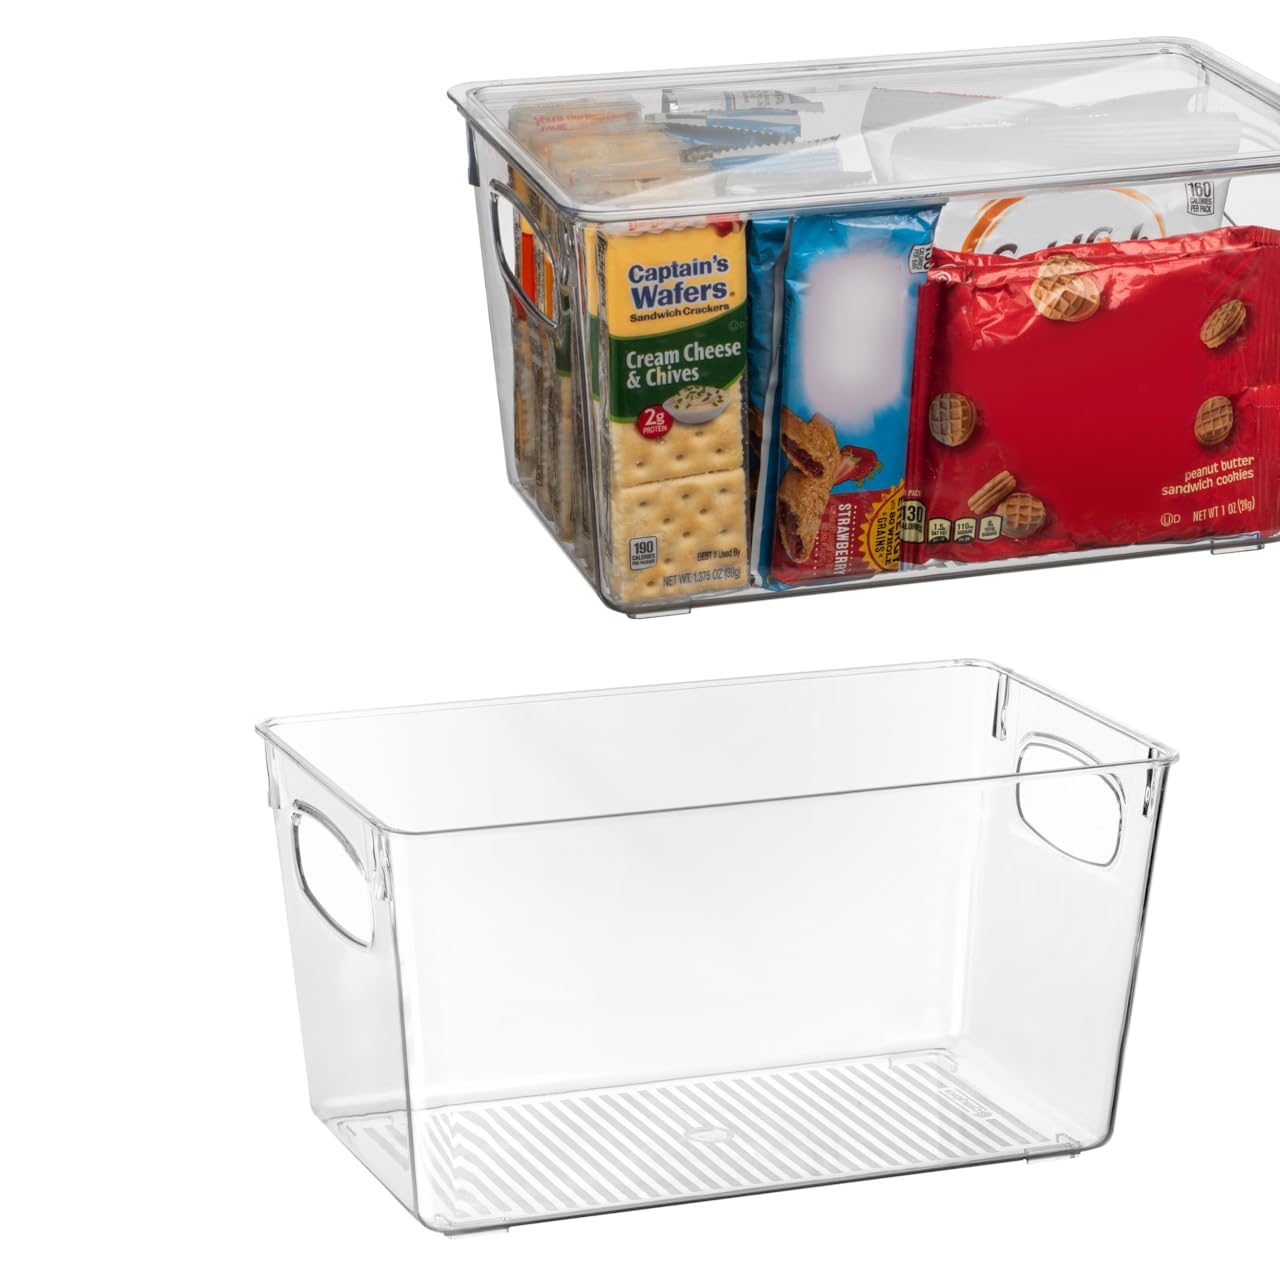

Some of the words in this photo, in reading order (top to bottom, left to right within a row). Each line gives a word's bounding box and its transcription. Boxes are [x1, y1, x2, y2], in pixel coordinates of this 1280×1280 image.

[1187, 196, 1213, 207] CALORIES
[1190, 205, 1200, 213] PER
[627, 254, 729, 285] Captain's
[630, 281, 728, 311] Wafers
[629, 308, 682, 323] Sandwich
[683, 302, 730, 316] Crackers
[626, 349, 680, 370] Cream
[683, 341, 742, 362] Cheese
[626, 372, 641, 389] &
[646, 365, 700, 387] Chives
[643, 408, 665, 426] 2g
[642, 424, 668, 435] PROTEIN
[1184, 462, 1219, 482] peanut
[1220, 456, 1255, 470] butter
[1161, 478, 1214, 496] sandwich
[1216, 469, 1255, 486] cookies
[901, 505, 924, 522] 130
[1192, 509, 1207, 523] NET
[1208, 507, 1220, 521] WT
[1227, 503, 1238, 515] OZ
[1238, 496, 1256, 515] (28g)
[633, 540, 654, 554] 190
[832, 503, 852, 575] STRAWBERRY
[874, 517, 888, 553] GRAINS
[885, 526, 895, 566] WHOLE
[697, 551, 713, 562] BEST
[718, 550, 733, 560] Used
[662, 576, 678, 587] NET
